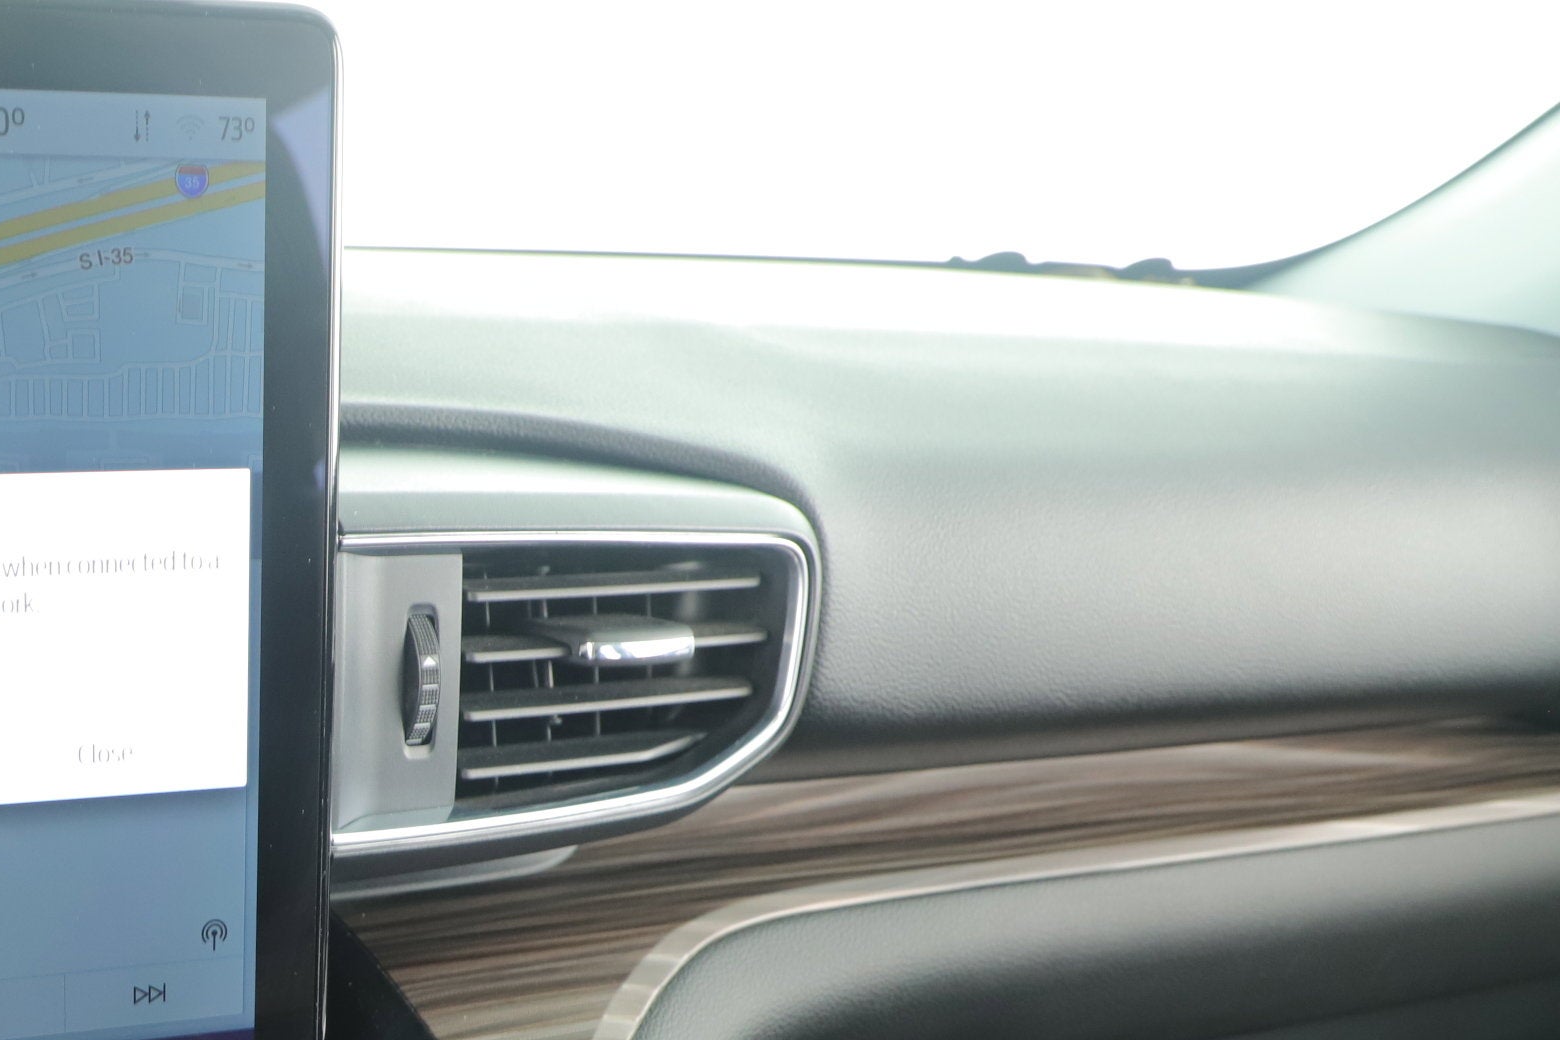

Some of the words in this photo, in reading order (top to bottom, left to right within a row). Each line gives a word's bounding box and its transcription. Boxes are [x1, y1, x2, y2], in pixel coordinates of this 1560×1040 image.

[79, 253, 93, 271] S
[98, 246, 134, 267] I-35
[3, 556, 61, 578] when
[67, 550, 176, 575] connected
[182, 552, 203, 570] to
[77, 744, 134, 764] Close
